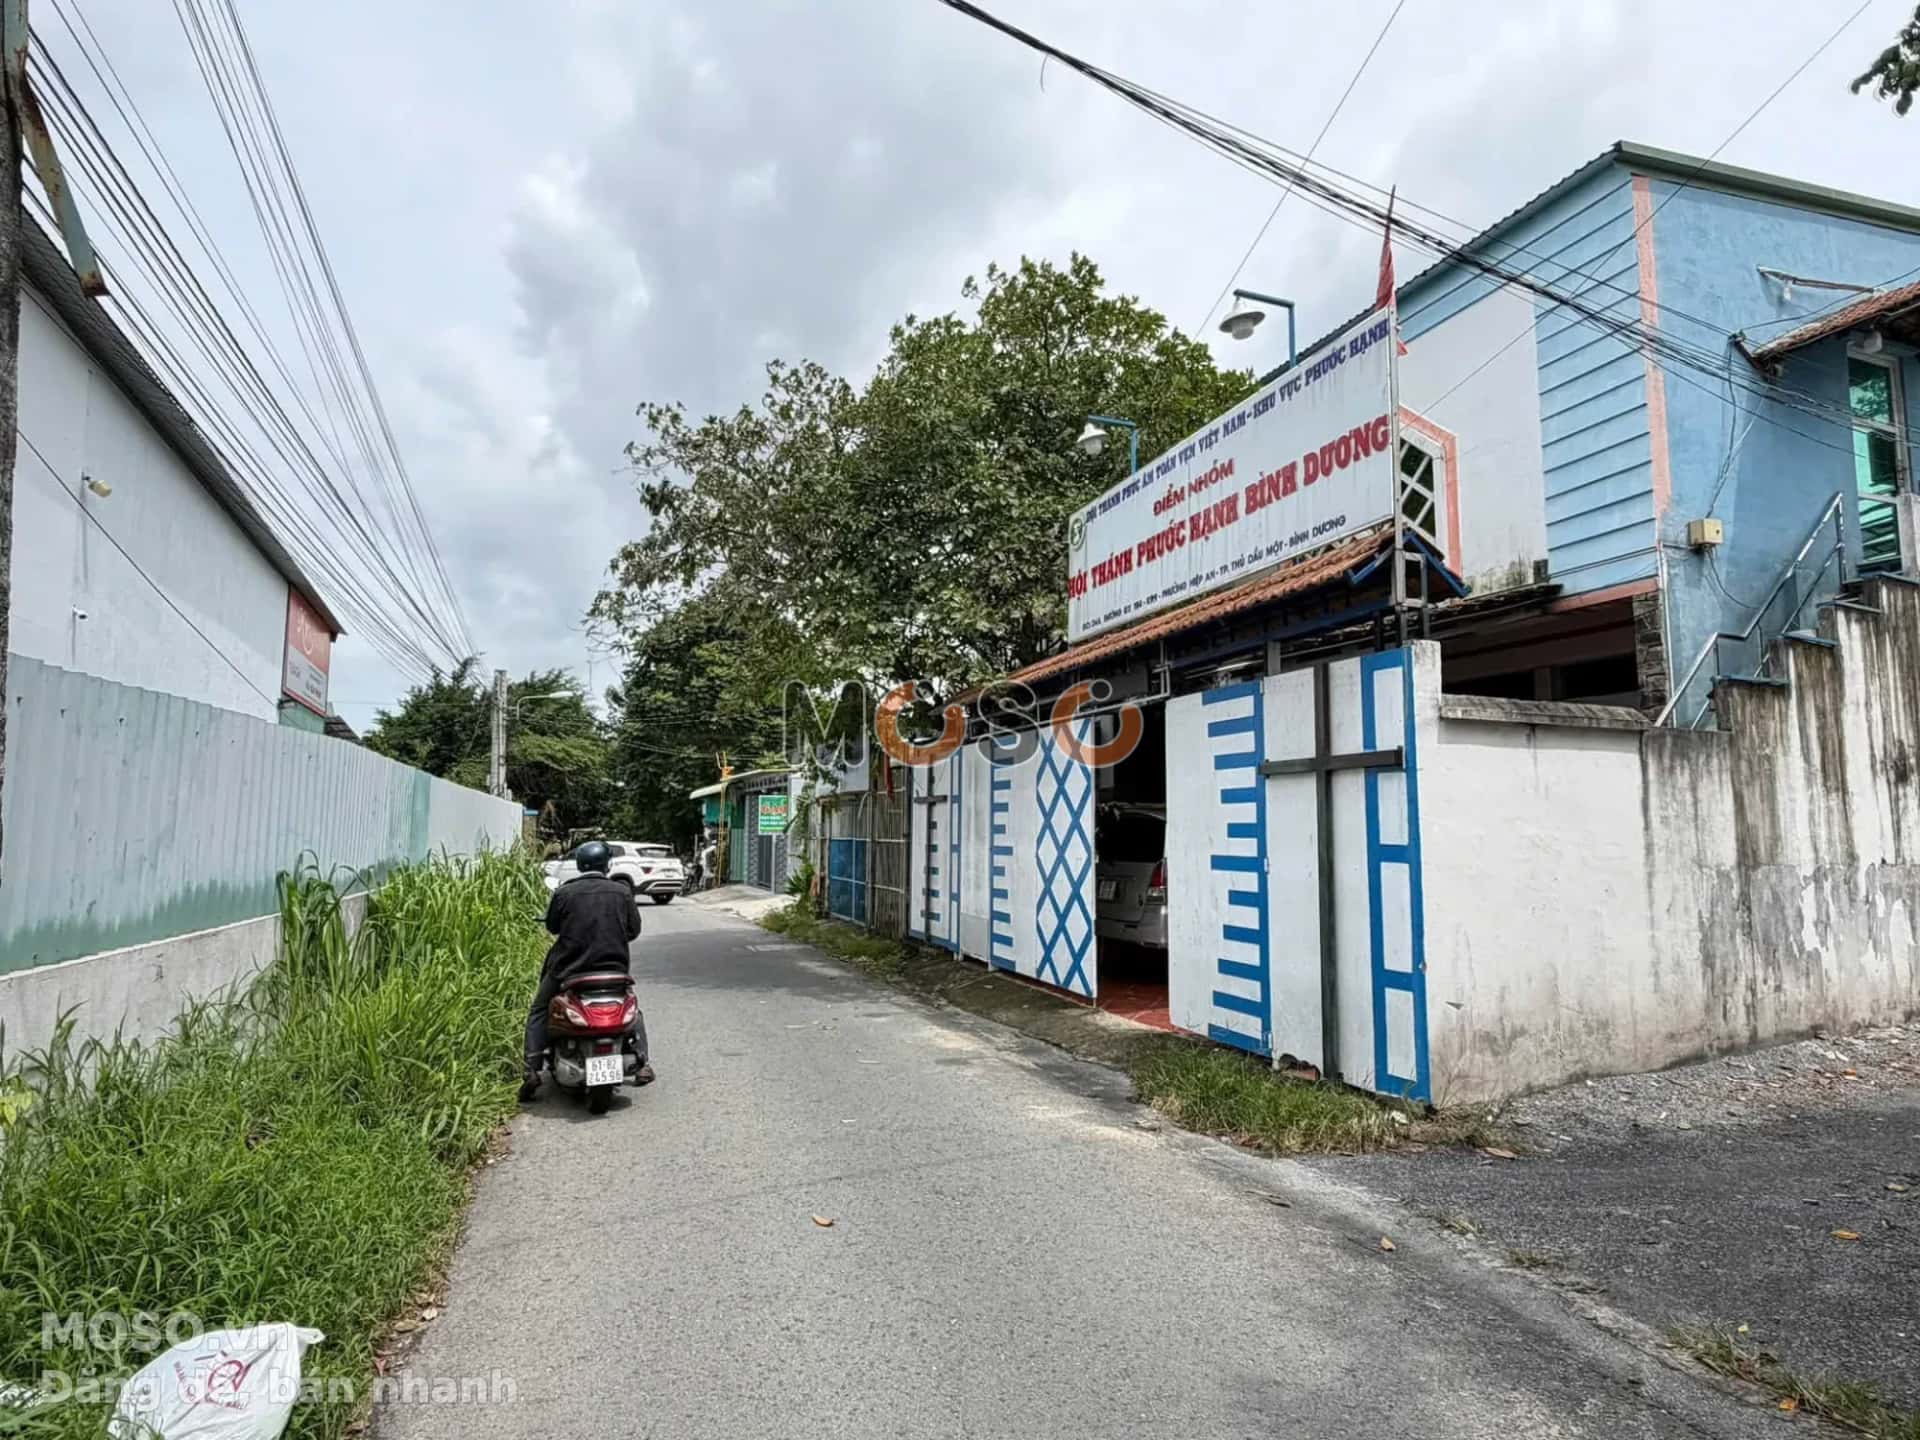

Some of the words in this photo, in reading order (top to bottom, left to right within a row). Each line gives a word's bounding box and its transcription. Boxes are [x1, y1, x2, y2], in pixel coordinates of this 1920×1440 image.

[1198, 427, 1221, 450] VIỆT
[1279, 375, 1302, 400] VỰC
[1304, 343, 1346, 387] PHƯỚC
[1349, 318, 1390, 358] HẠNH
[1067, 569, 1088, 601] HỘI
[1091, 547, 1134, 589] THÁNH
[1137, 519, 1186, 568] PHƯỚC
[1188, 492, 1240, 540] HẠNH
[1244, 460, 1298, 515] BÌNH
[1302, 414, 1391, 487] DƯƠNG
[1153, 483, 1186, 516] ĐIỂM
[1188, 458, 1235, 495] NHÓM
[1312, 514, 1346, 537] DƯƠNG
